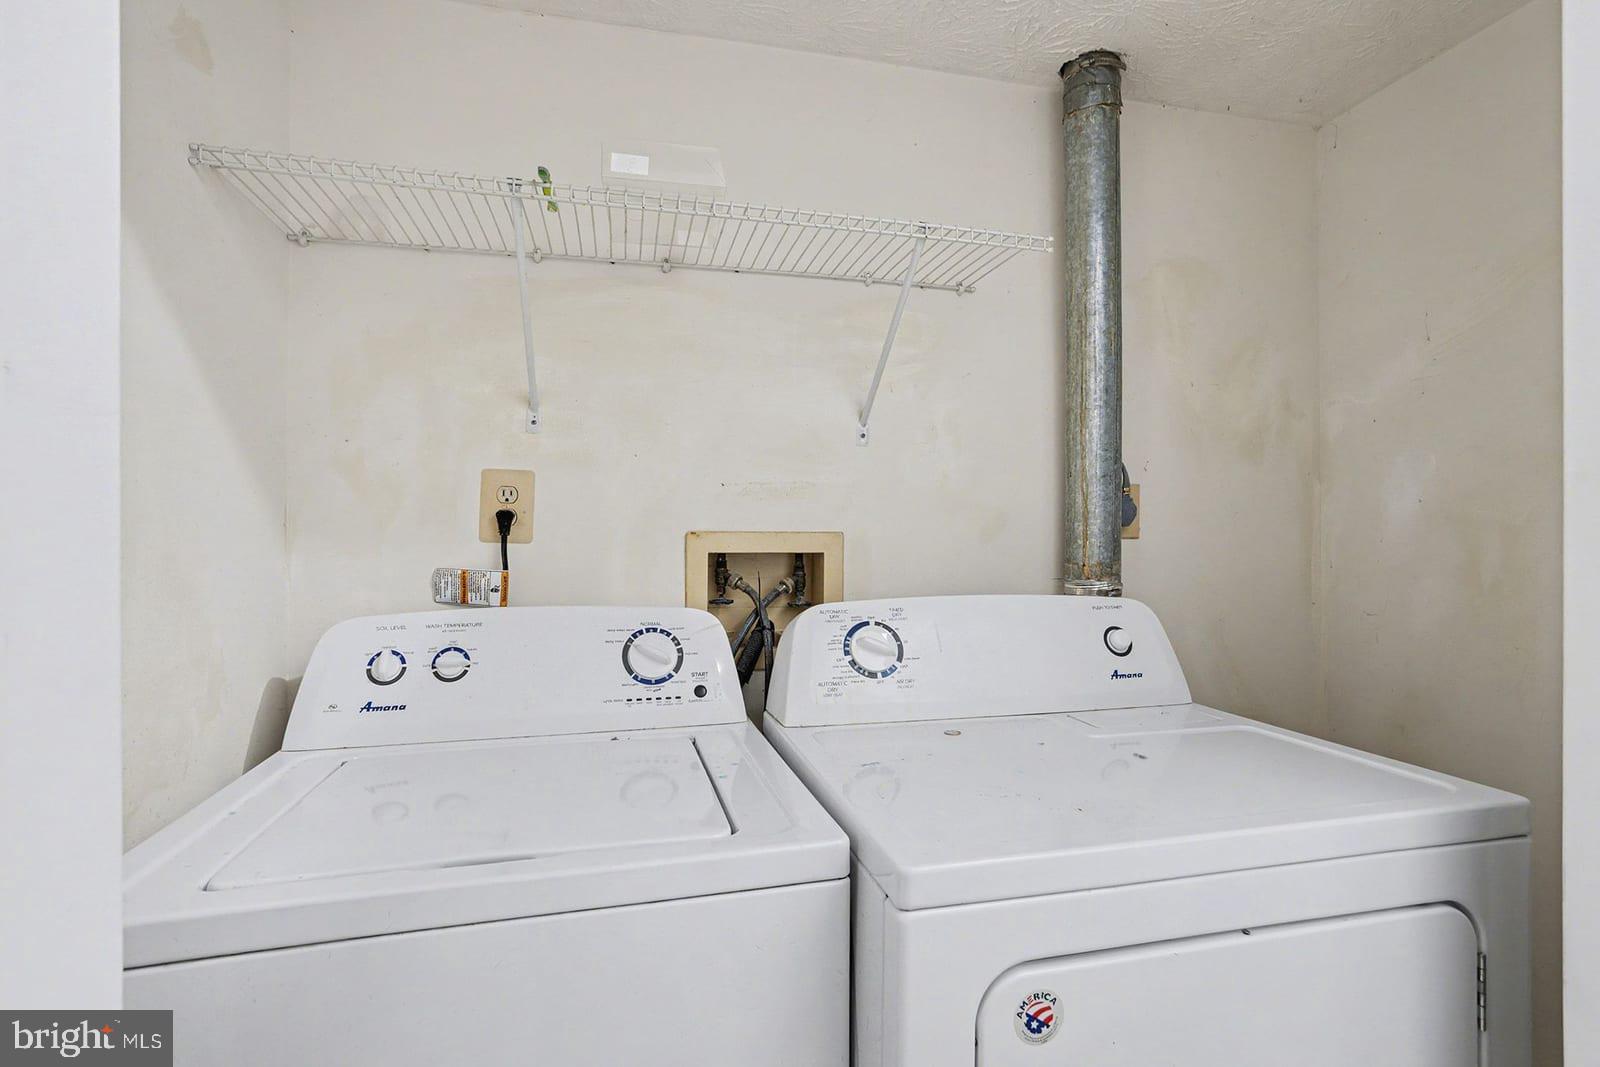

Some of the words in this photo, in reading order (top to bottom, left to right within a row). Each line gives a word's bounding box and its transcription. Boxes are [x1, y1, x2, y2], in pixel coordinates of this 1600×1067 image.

[1110, 669, 1143, 680] Amana
[359, 701, 407, 713] Amana
[1016, 992, 1057, 1019] AMERICA
